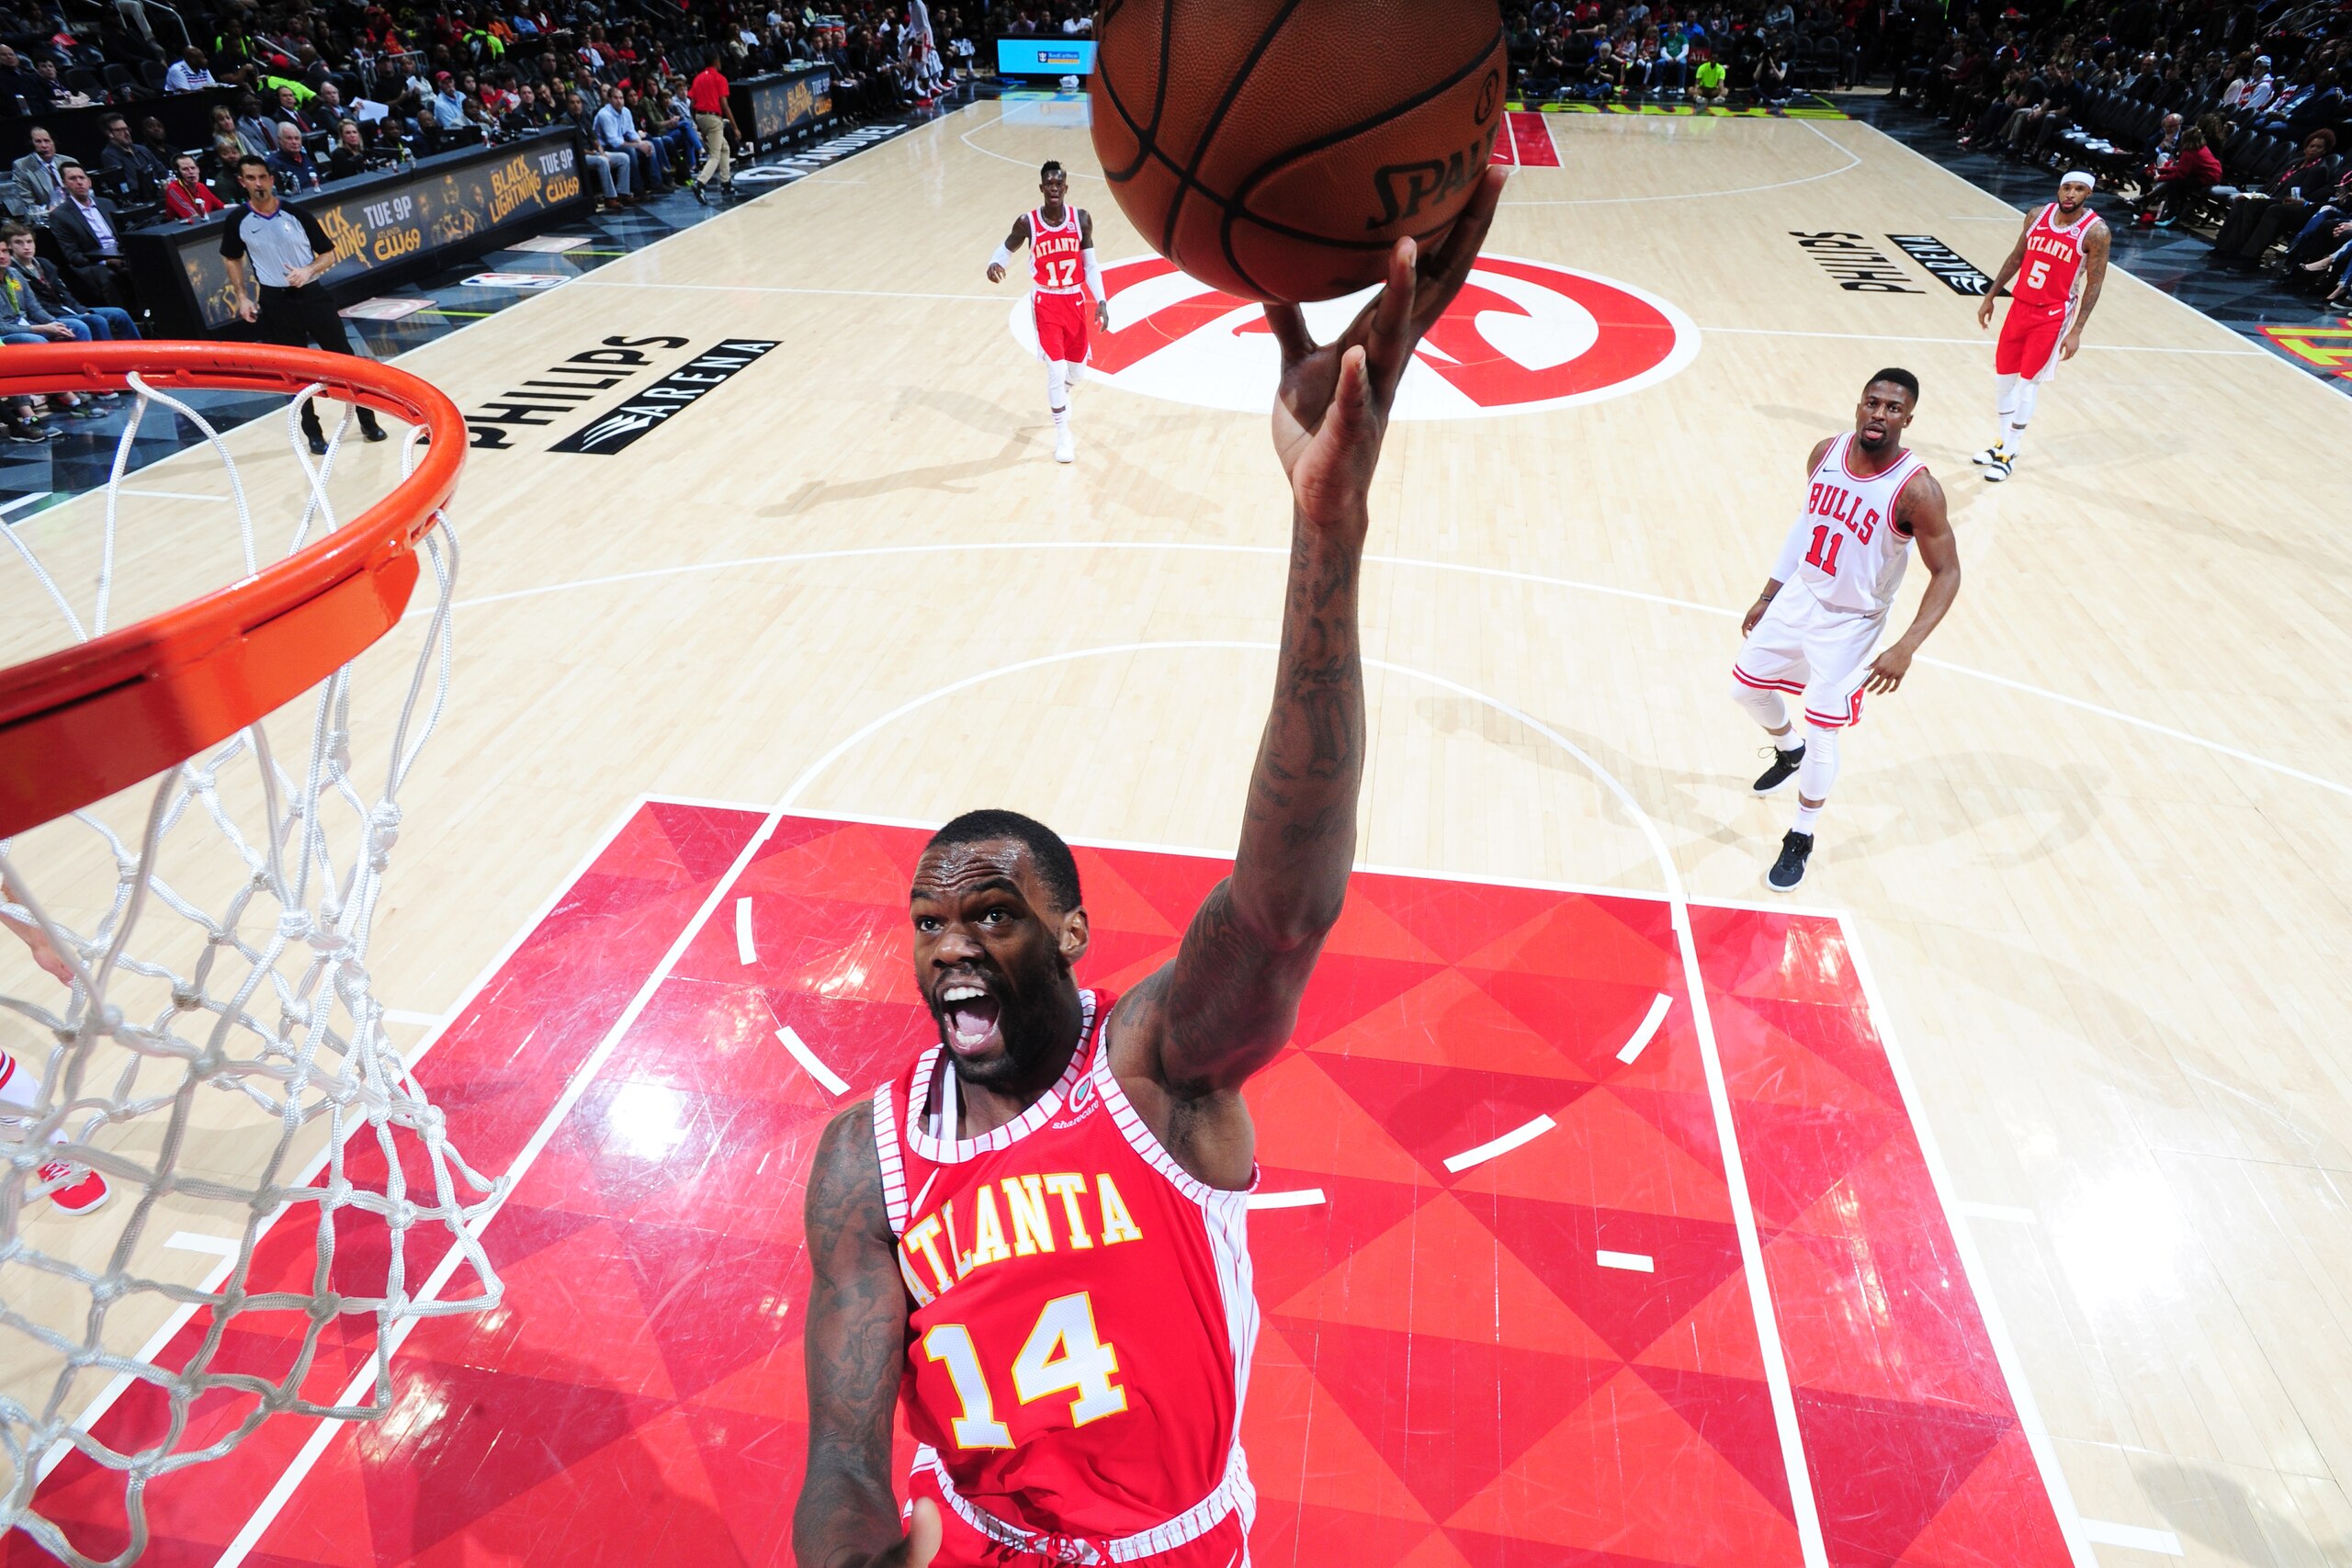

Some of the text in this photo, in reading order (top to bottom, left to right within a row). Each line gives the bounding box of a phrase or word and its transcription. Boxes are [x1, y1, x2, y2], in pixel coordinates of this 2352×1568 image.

[538, 148, 574, 175] TUE 9P
[776, 124, 908, 166] FANDUEL
[489, 169, 543, 223] LIGHTNING
[491, 154, 531, 197] BLACK
[546, 176, 580, 203] CW69
[363, 195, 413, 230] TUE 9P
[374, 228, 421, 261] CW69
[1035, 237, 1080, 258] ATLANTA
[1788, 231, 1927, 294] PHILIPS
[1891, 235, 1987, 279] ARENA
[2027, 235, 2074, 263] ATLANTA
[1046, 258, 1077, 287] 17
[2027, 260, 2051, 289] 5
[415, 336, 690, 449] PHILIPS
[619, 343, 775, 419] ARENA
[1808, 482, 1880, 546] BULLS
[1805, 525, 1843, 577] 11
[1052, 1100, 1099, 1129] sharecare
[922, 1291, 1129, 1450] 14
